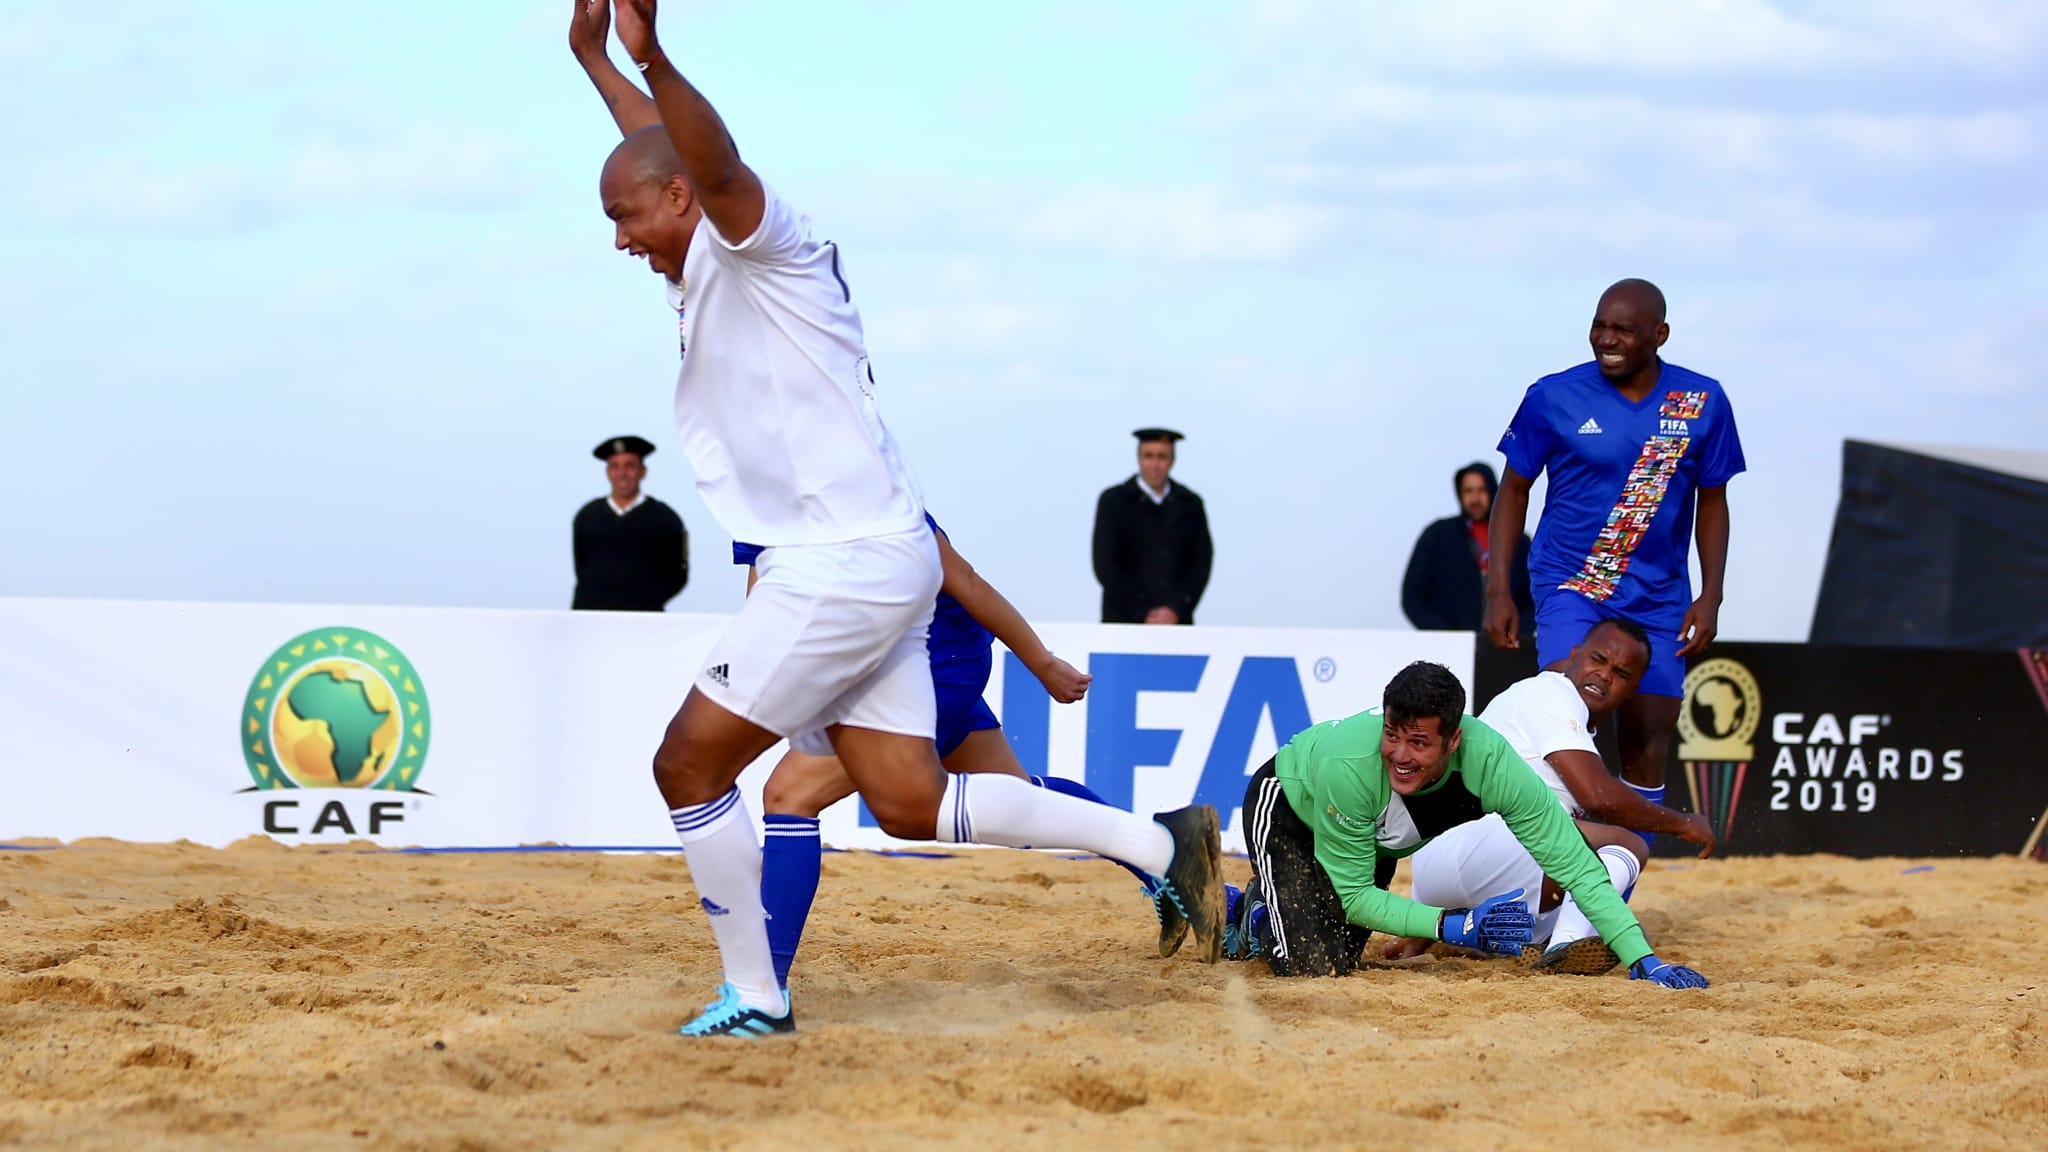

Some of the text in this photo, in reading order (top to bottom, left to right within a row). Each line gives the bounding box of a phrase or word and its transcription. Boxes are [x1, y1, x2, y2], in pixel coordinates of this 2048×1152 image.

[1660, 420, 1688, 430] FIFA
[858, 652, 1316, 831] IFA
[1772, 713, 1880, 745] CAF
[1771, 747, 1964, 781] AWARDS
[1770, 780, 1877, 812] 2019
[263, 800, 404, 834] CAF
